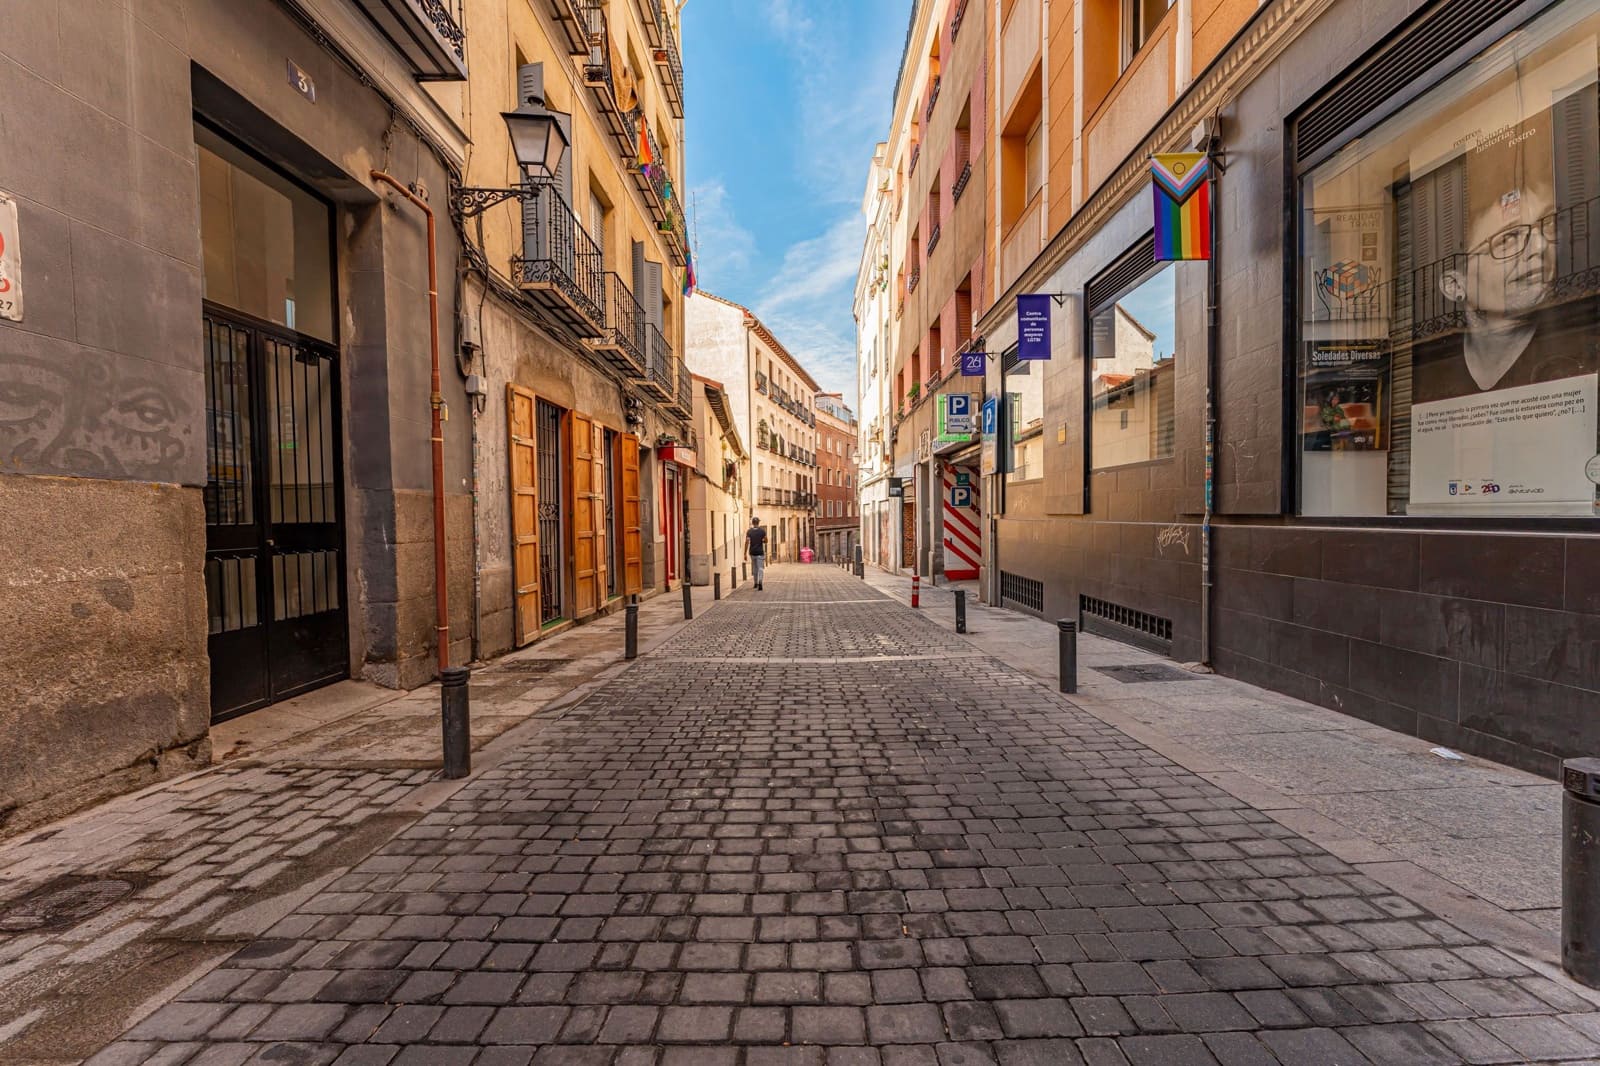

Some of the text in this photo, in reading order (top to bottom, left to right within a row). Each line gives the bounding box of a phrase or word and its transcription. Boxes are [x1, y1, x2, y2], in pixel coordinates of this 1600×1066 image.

[298, 70, 308, 92] 3
[1509, 128, 1536, 148] rostro
[1312, 350, 1381, 360] Soledades Diversas
[1563, 390, 1581, 398] mujer
[952, 397, 965, 415] P
[1520, 403, 1546, 412] estuviera
[986, 407, 992, 434] P
[955, 489, 967, 504] P
